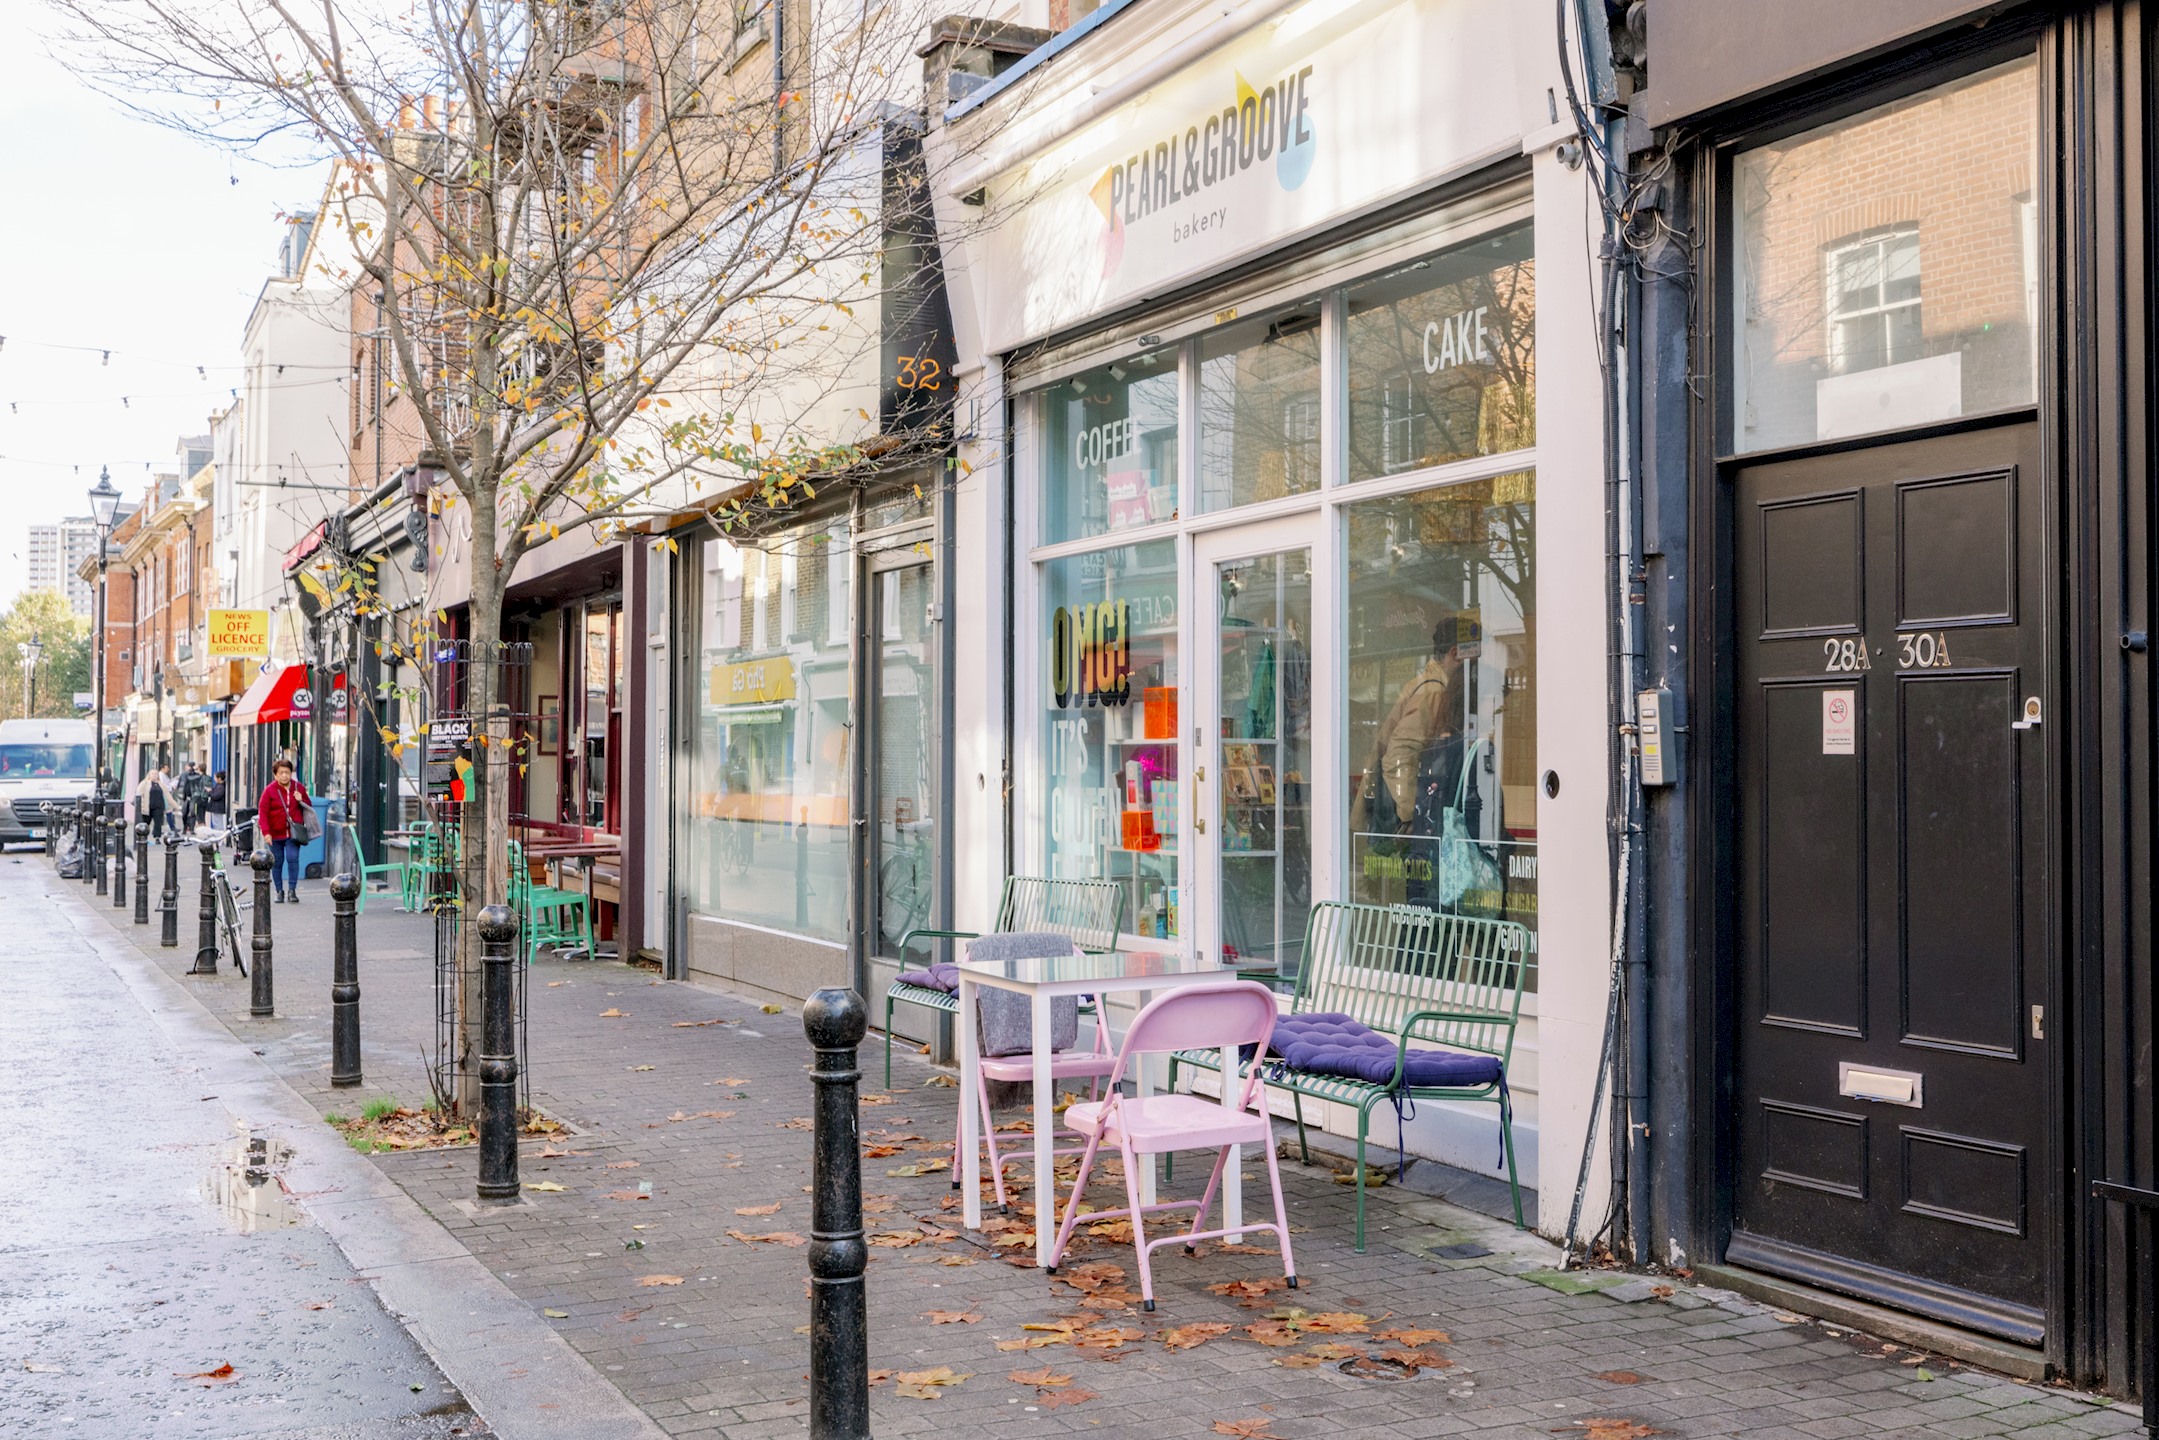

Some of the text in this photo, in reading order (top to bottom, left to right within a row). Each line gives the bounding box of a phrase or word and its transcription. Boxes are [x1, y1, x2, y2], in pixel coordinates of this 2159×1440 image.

[1110, 64, 1313, 232] PEARL&GROOVE
[1173, 206, 1227, 243] bakery
[1423, 306, 1489, 374] CAKE
[896, 356, 941, 391] 32
[1075, 413, 1143, 471] COFFEE
[211, 633, 265, 645] LICENCE
[227, 621, 251, 632] OFF
[216, 645, 260, 653] GROCERY
[1053, 598, 1130, 707] OMG!
[1824, 637, 1872, 672] 28A
[1898, 632, 1952, 668] 30A
[431, 723, 469, 735] BLACK
[1052, 787, 1121, 846] GUTEN
[1363, 855, 1433, 881] BIRTHDAY CAKES
[1509, 855, 1538, 879] DAIRY
[1501, 928, 1538, 954] GUTN
